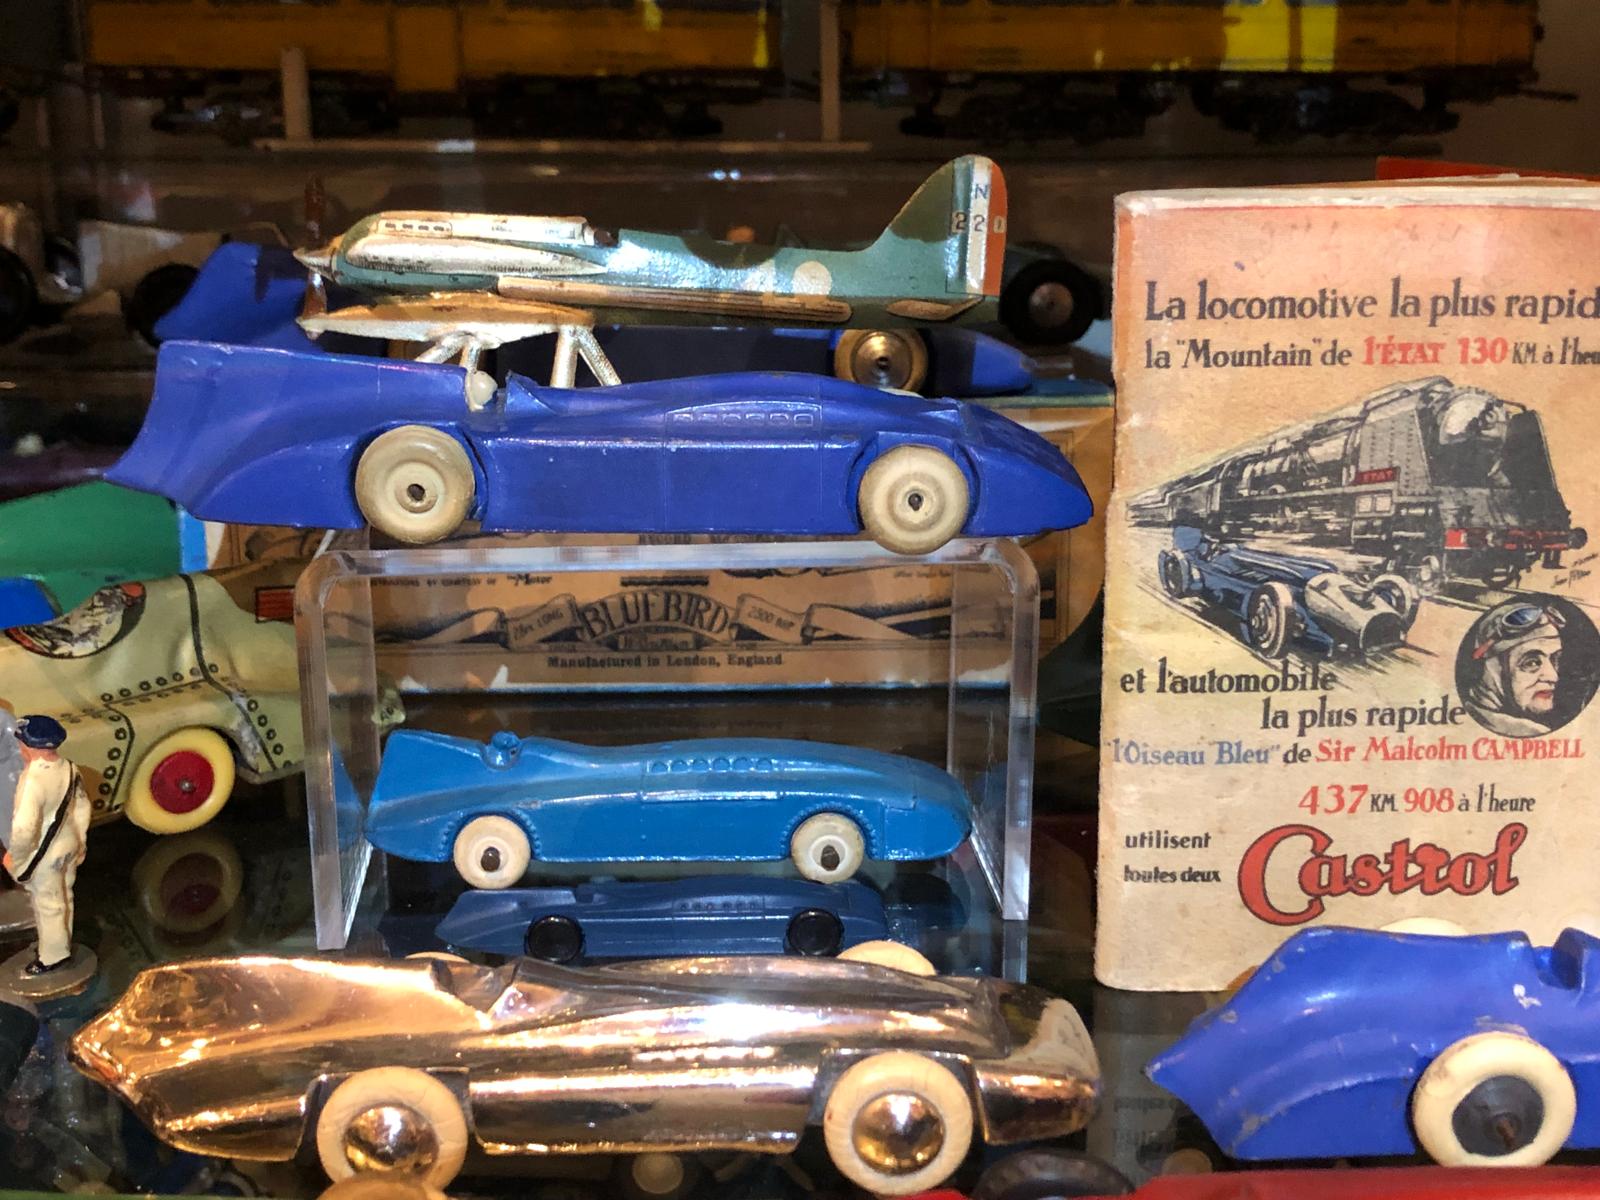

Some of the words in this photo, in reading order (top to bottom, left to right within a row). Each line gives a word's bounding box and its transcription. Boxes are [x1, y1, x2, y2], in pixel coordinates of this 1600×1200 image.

[974, 183, 989, 200] N
[1145, 280, 1186, 321] La
[1197, 278, 1378, 321] locomotive
[1390, 275, 1421, 318] la
[1428, 277, 1496, 328] plus
[1145, 338, 1171, 369] la
[1320, 339, 1352, 366] de
[1457, 336, 1509, 365] 130
[1542, 344, 1554, 365] à
[578, 589, 730, 641] BLUEBIRD
[548, 654, 642, 669] Manufactured
[648, 654, 661, 668] in
[667, 654, 721, 670] London,
[728, 653, 783, 669] England
[1120, 668, 1147, 694] et
[1156, 656, 1339, 694] l'automobile
[1260, 696, 1289, 730] la
[1297, 695, 1357, 738] plus
[1366, 694, 1467, 733] rapide
[1282, 743, 1312, 765] de
[1315, 738, 1356, 763] Sir
[1362, 736, 1467, 763] Malcolm
[1471, 736, 1586, 761] CAMPBELL
[1298, 784, 1369, 816] 437
[1404, 787, 1456, 813] 908
[1457, 793, 1471, 812] à
[1476, 783, 1537, 813] l'heure
[1125, 829, 1212, 849] utilisent
[1123, 864, 1177, 884] toutes
[1180, 865, 1222, 883] deux
[1237, 821, 1528, 926] Castrol
